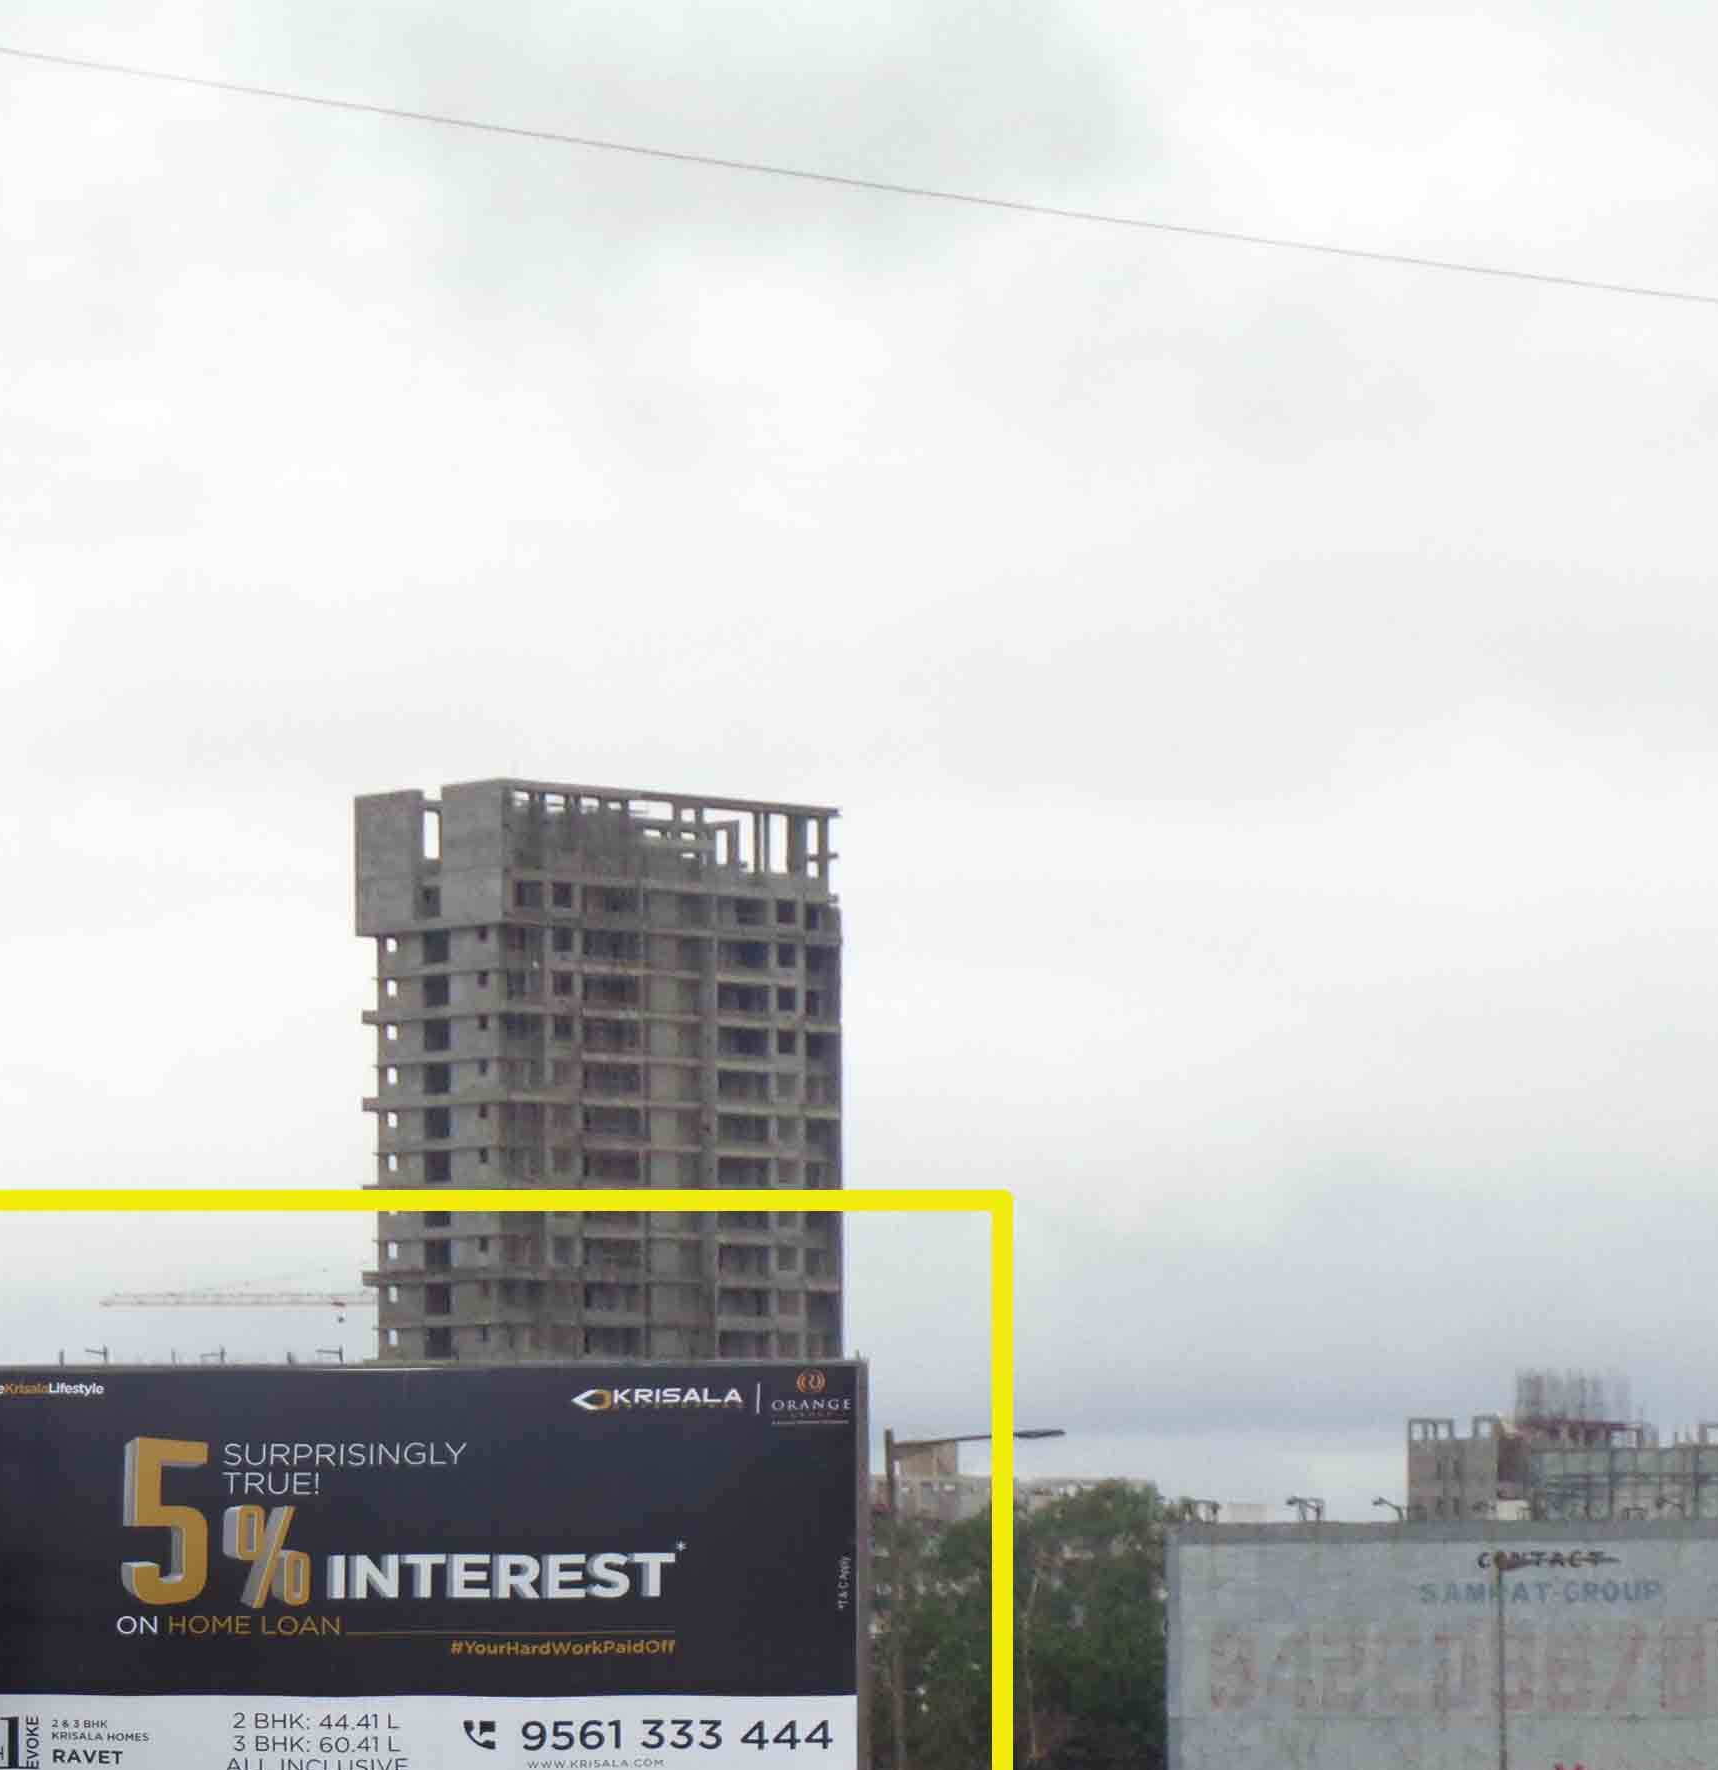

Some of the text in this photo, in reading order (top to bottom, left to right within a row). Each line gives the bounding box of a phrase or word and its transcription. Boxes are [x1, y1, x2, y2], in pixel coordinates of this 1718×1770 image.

[612, 1387, 744, 1404] KRISALA
[770, 1398, 852, 1411] ORANGE
[222, 1441, 468, 1466] SURPRISINGLY
[221, 1471, 321, 1496] TRUE!
[116, 1615, 342, 1635] ON HOME LOAN
[450, 1639, 676, 1656] #YourHardWorkPaidOff
[83, 1720, 108, 1729] BHK
[232, 1712, 245, 1729] 2
[319, 1712, 380, 1731] 44.41
[387, 1713, 401, 1730] L
[26, 1715, 40, 1770] EVOKE
[51, 1731, 150, 1742] KRISALA HOMES
[233, 1735, 246, 1752] 3
[319, 1735, 380, 1754] 60.41
[388, 1735, 401, 1752] L
[521, 1719, 834, 1752] 9561 333 444
[52, 1749, 124, 1765] RAVET
[526, 1758, 665, 1769] WWW.KRISALA.COM
